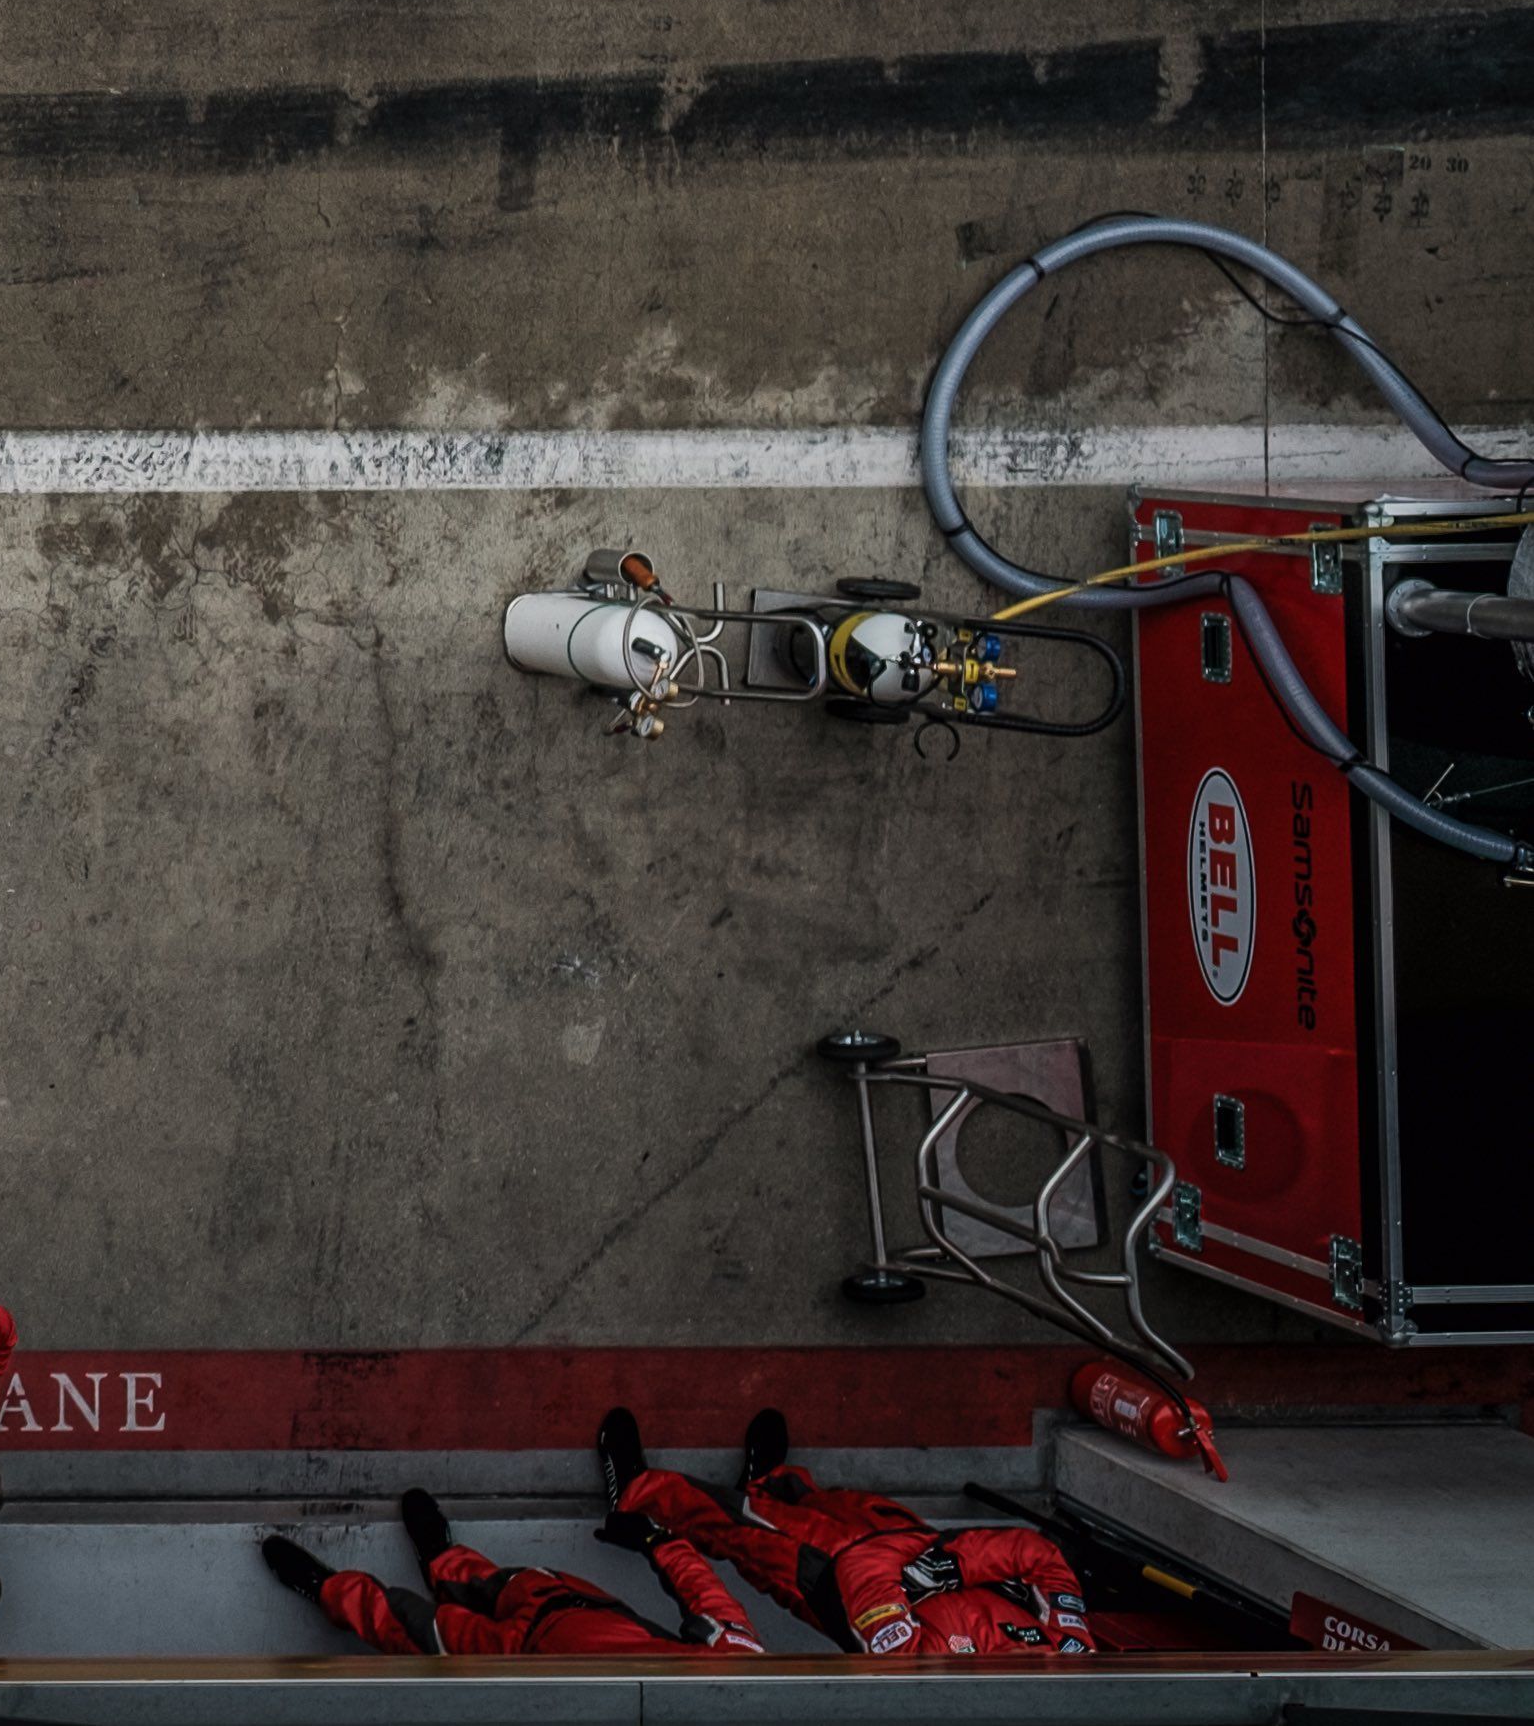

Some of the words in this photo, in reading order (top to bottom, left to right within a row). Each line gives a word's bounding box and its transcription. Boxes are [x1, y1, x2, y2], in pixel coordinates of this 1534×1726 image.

[1198, 821, 1209, 944] HELMETS
[1208, 805, 1240, 968] BELL
[1290, 780, 1317, 1032] Samsonite
[1323, 1615, 1393, 1652] CORSA
